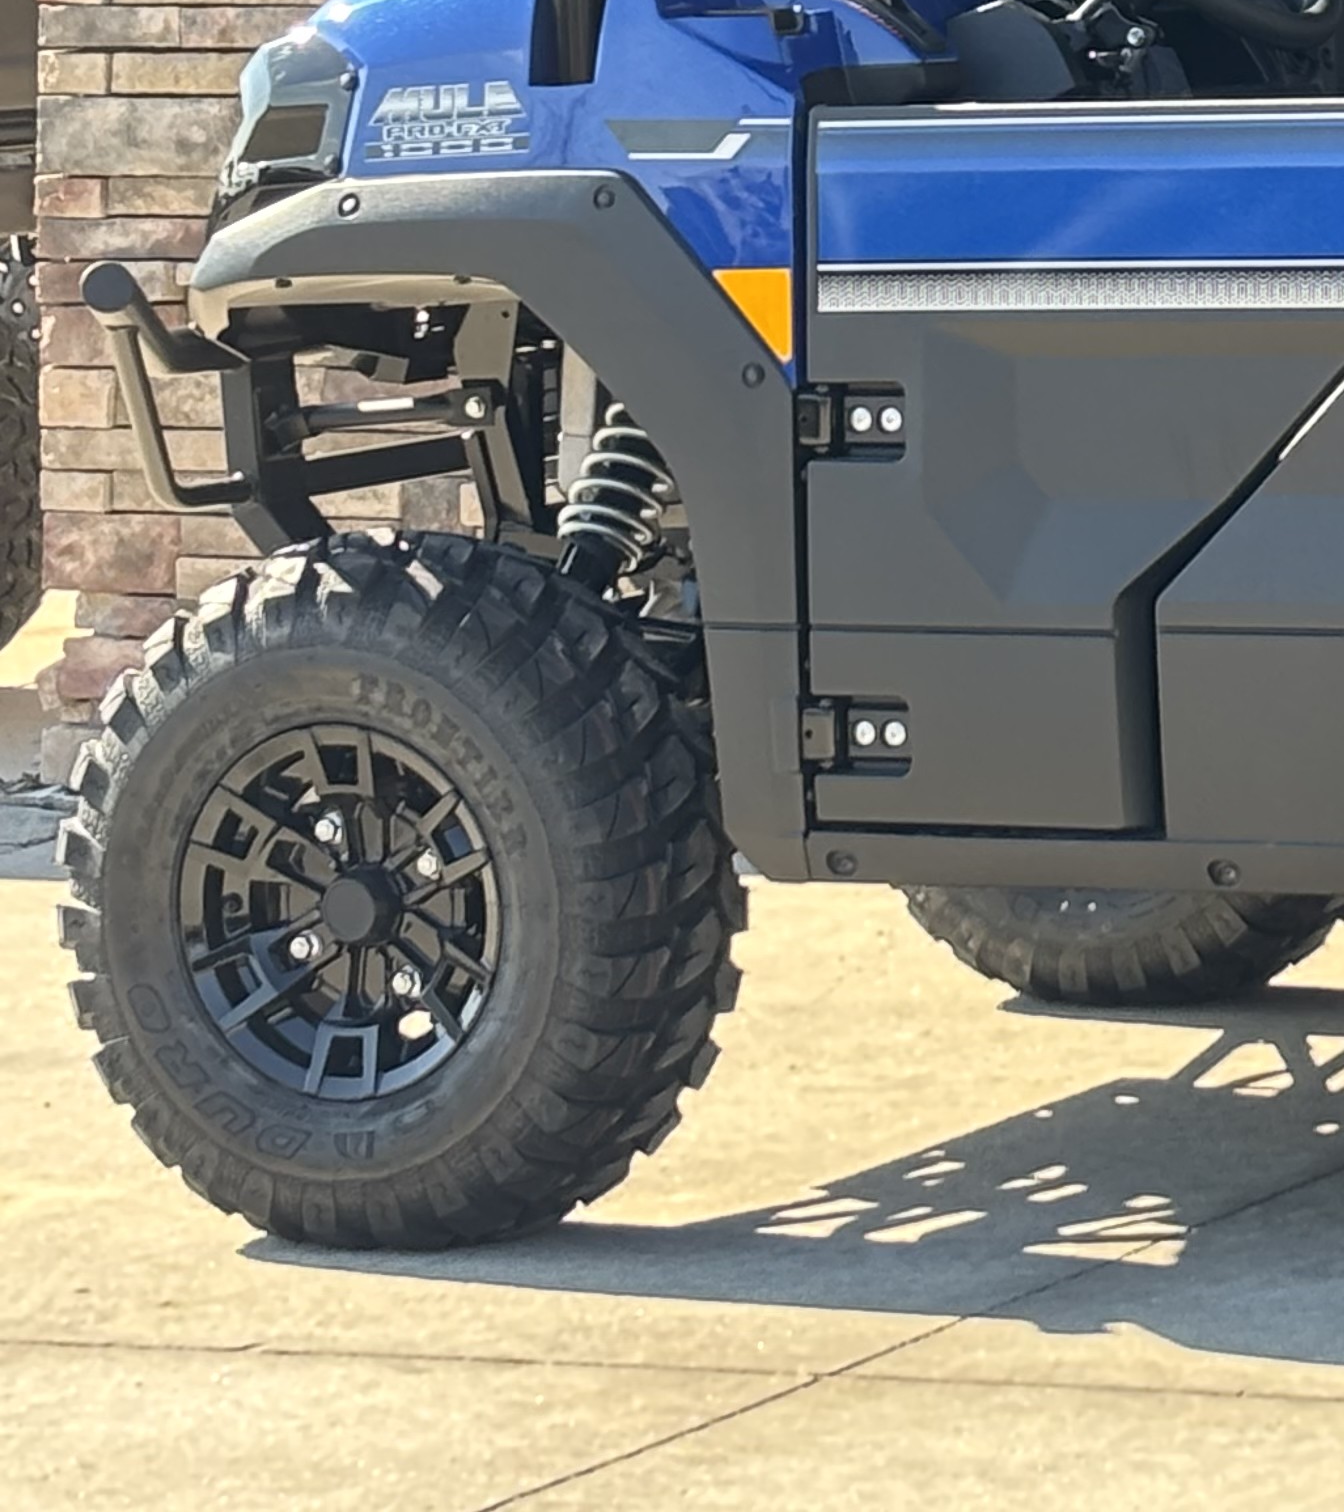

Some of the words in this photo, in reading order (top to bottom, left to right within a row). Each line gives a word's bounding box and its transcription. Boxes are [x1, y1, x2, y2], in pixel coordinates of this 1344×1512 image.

[369, 80, 527, 126] MULE
[381, 138, 513, 158] 1000
[126, 982, 313, 1161] DURO
